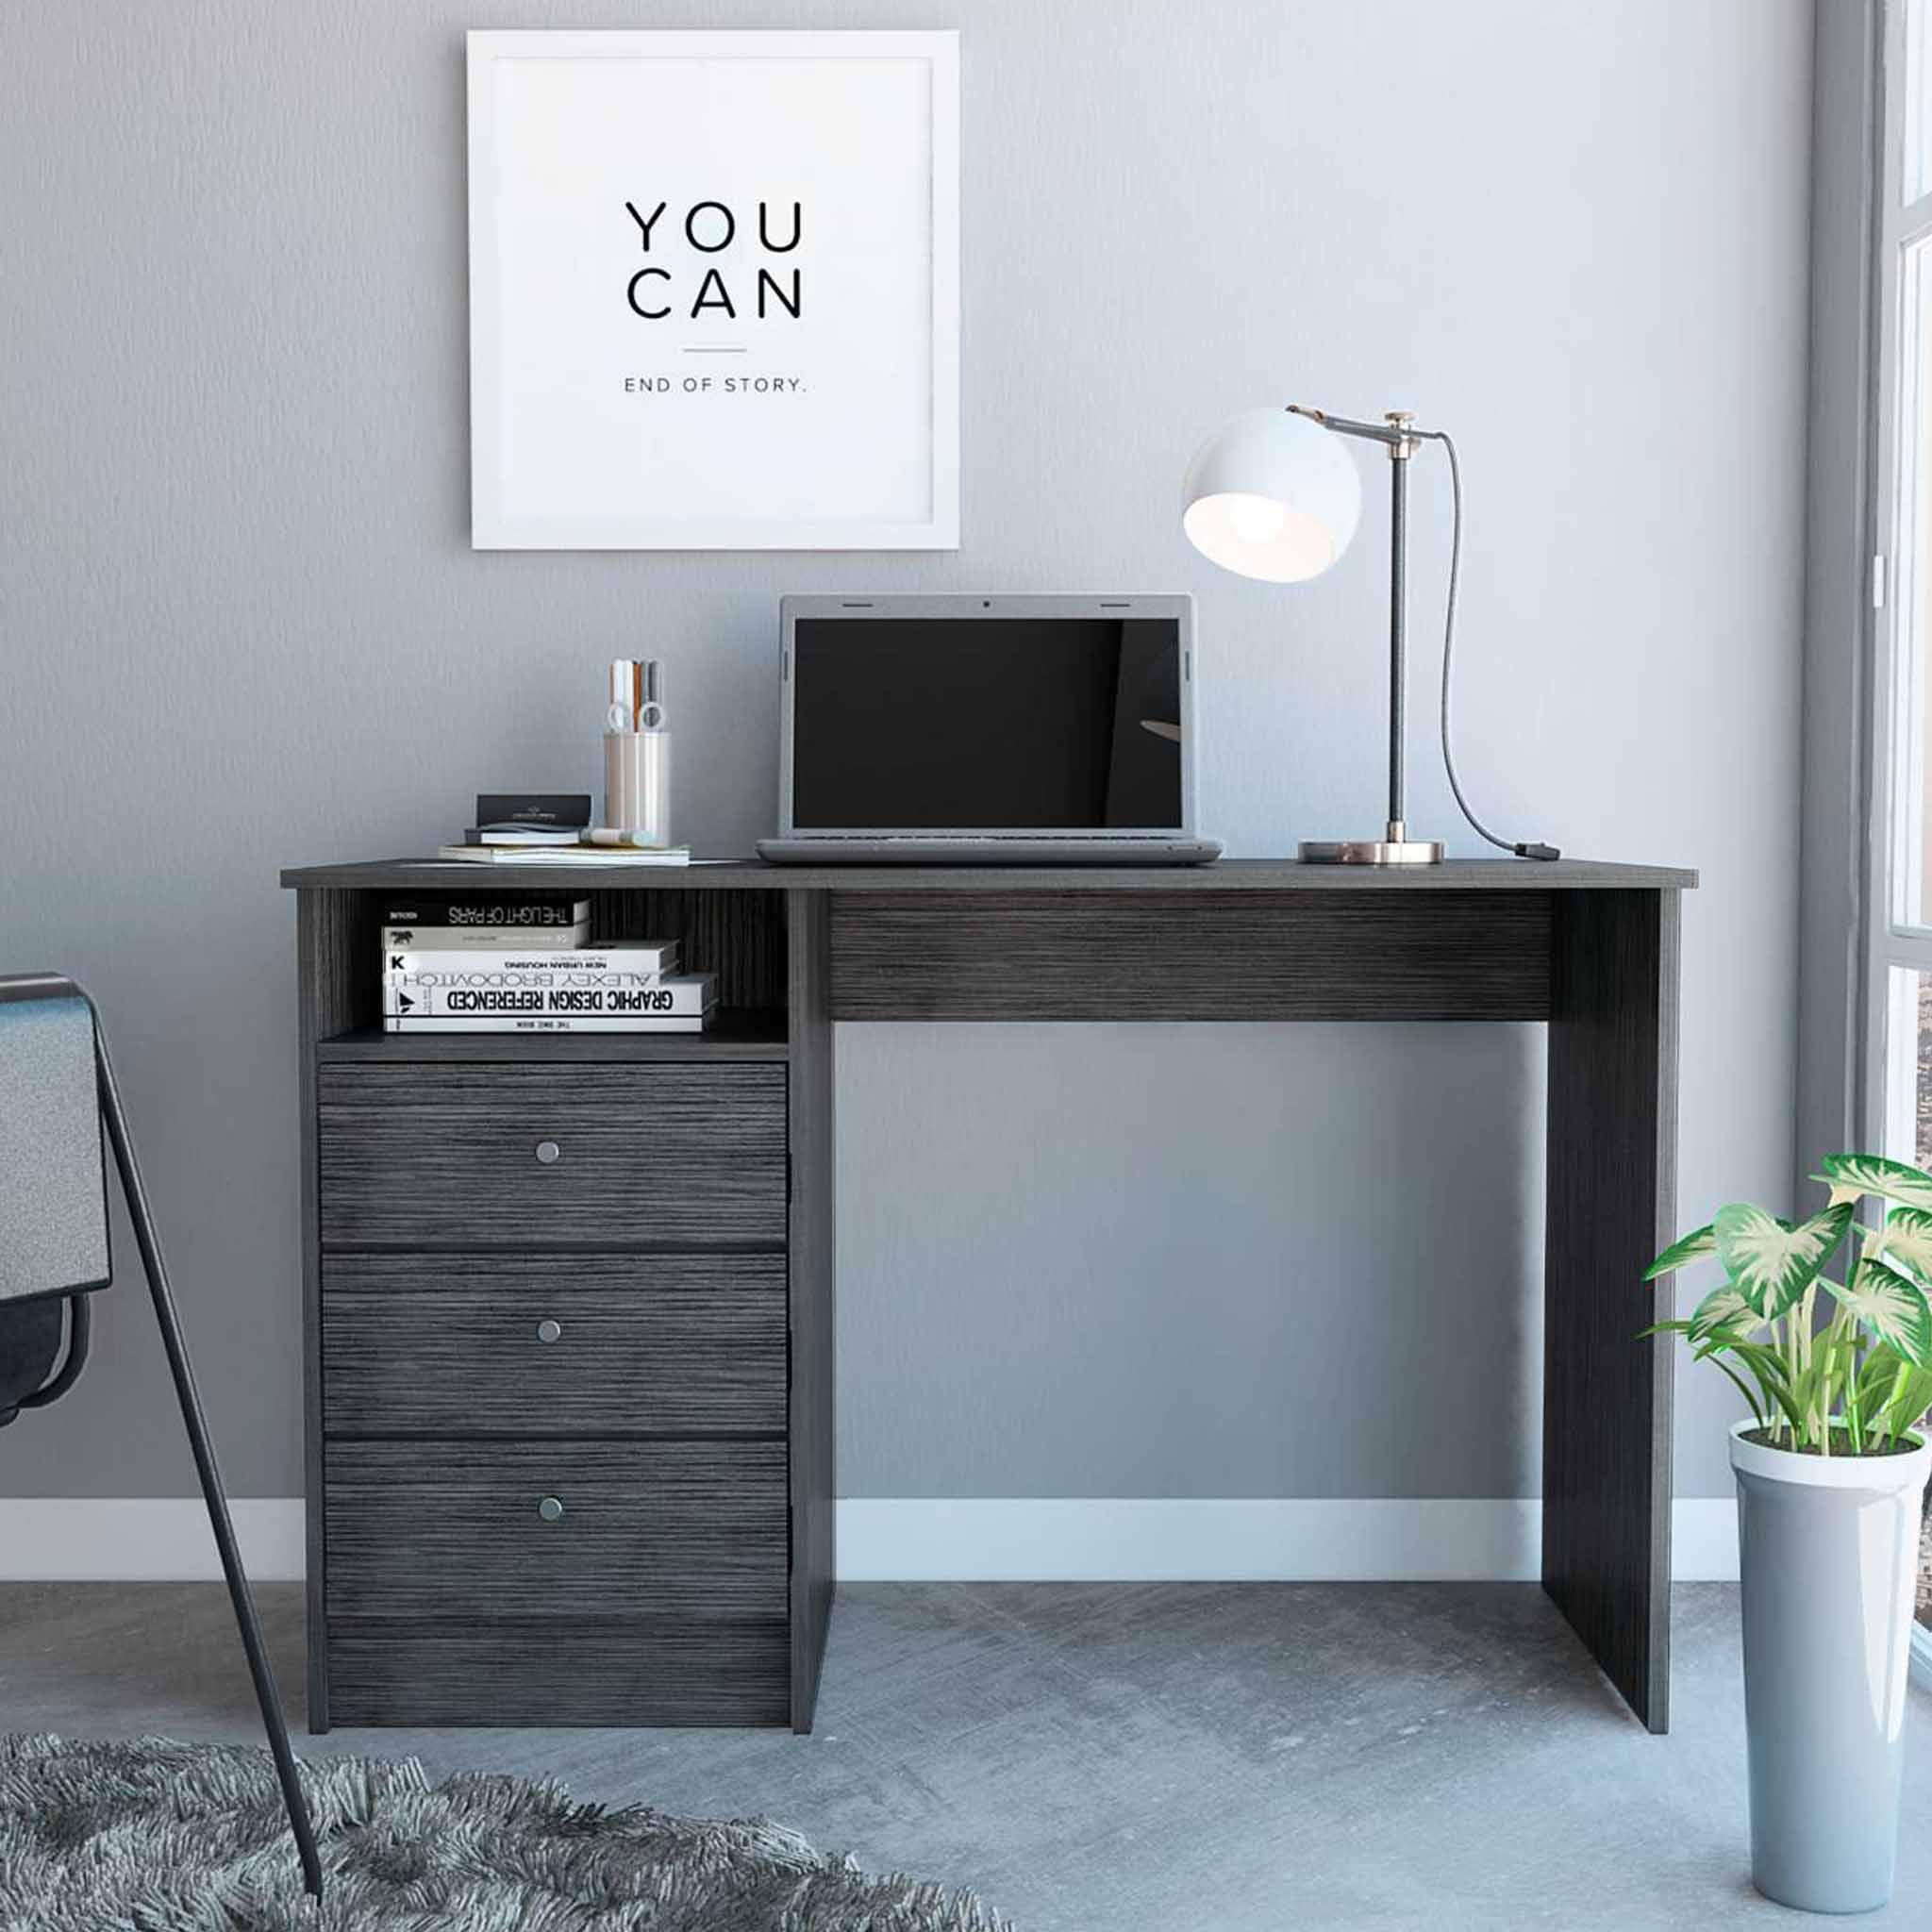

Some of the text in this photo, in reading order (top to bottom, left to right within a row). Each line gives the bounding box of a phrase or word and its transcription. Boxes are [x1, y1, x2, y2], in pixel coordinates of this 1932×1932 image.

[625, 201, 801, 253] YOU
[626, 268, 801, 319] CAN
[625, 377, 807, 392] END OF STORY.
[486, 907, 505, 924] OF
[543, 907, 568, 924] THE
[504, 961, 548, 970] HOUSING
[403, 973, 652, 987] ALEXEY BRODOVITCH
[446, 990, 544, 1011] REFERENCED
[548, 990, 603, 1011] DESIGN
[607, 990, 674, 1011] GRAPHIC
